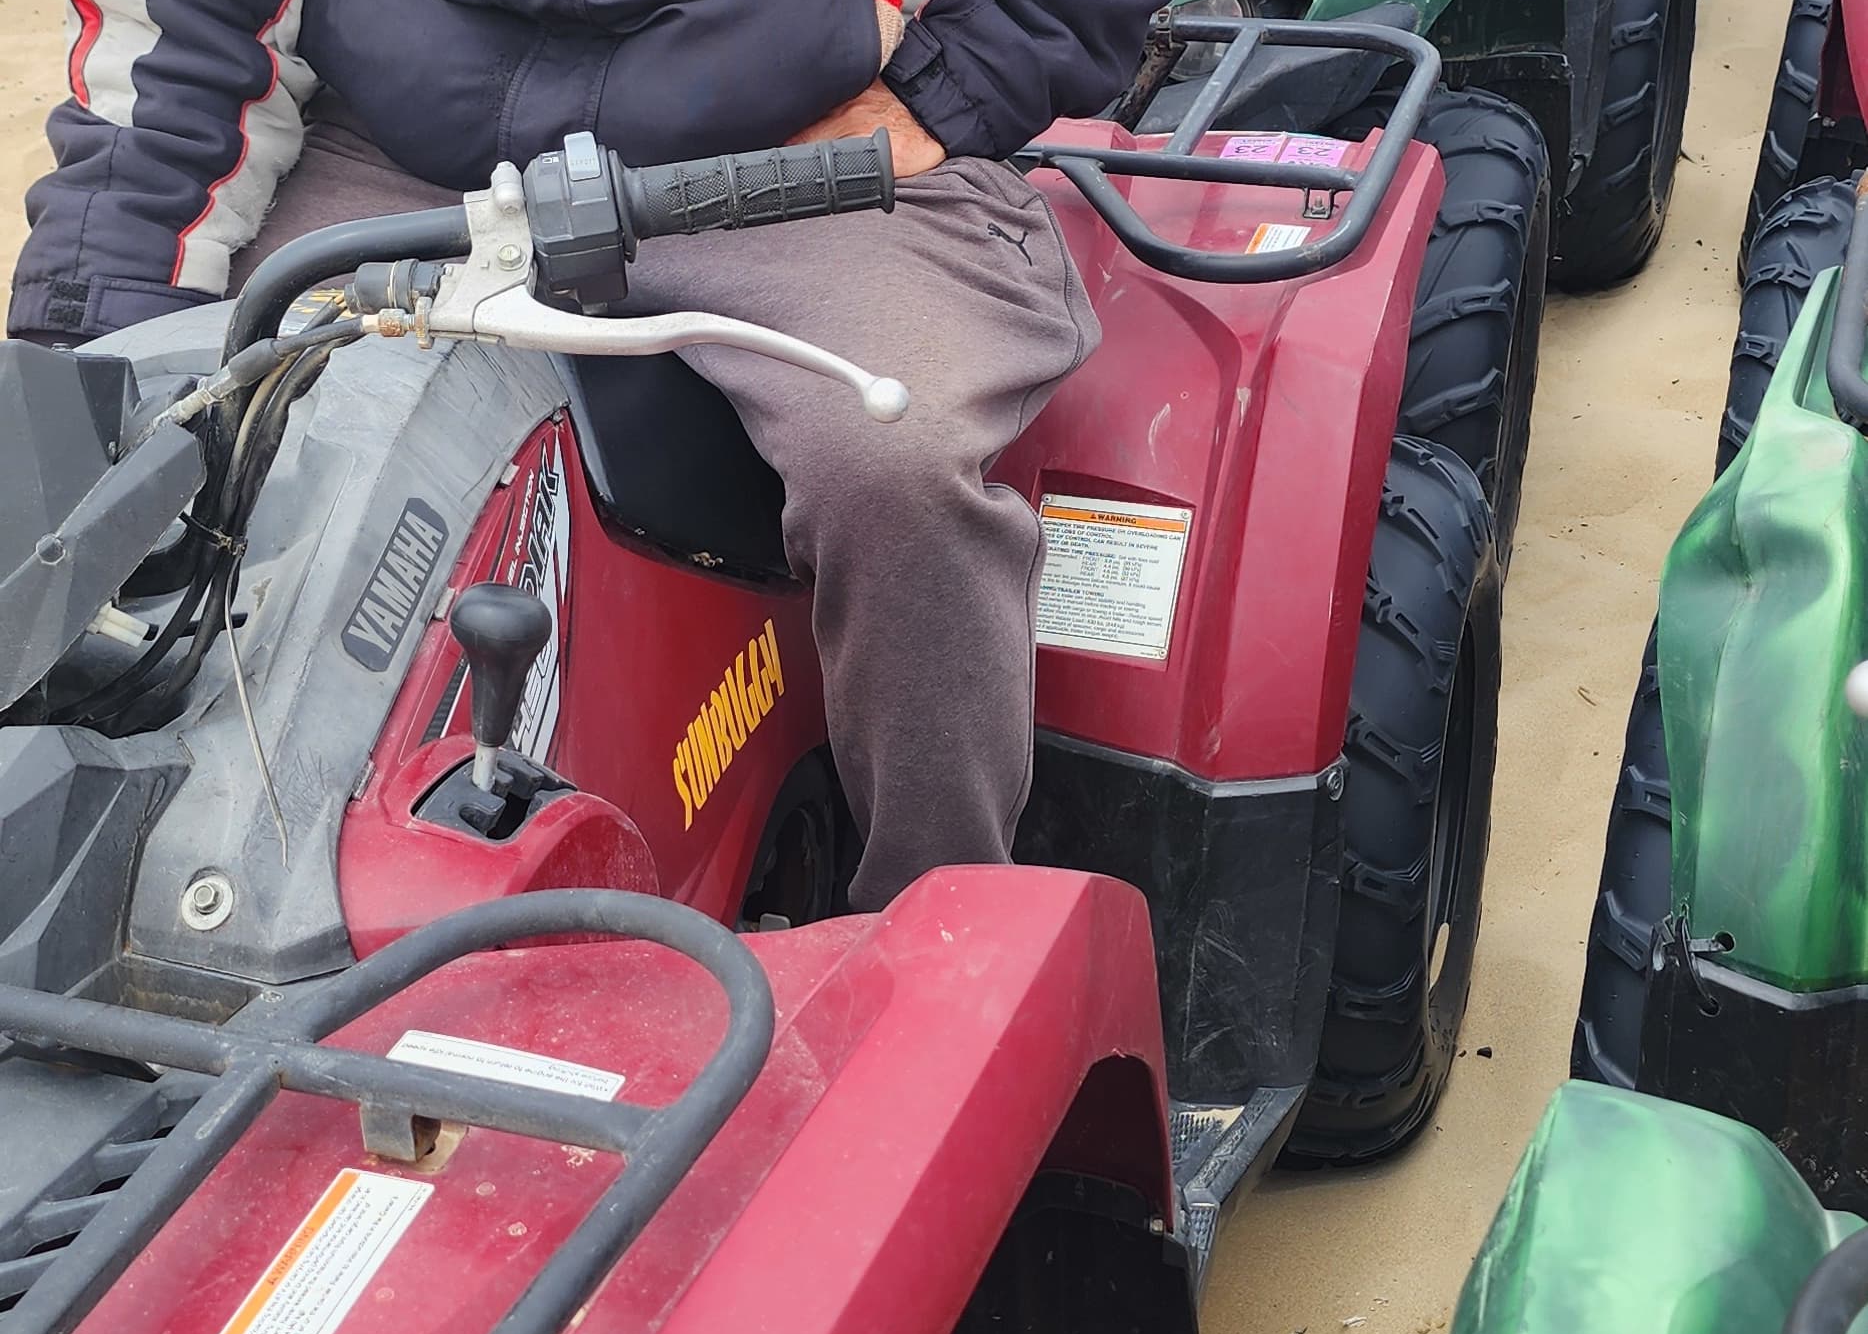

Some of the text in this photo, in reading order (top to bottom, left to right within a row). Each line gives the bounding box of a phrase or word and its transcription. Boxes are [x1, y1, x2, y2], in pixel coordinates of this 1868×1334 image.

[515, 467, 535, 556] INJECTION
[1097, 514, 1137, 525] WARNING
[348, 509, 446, 655] YAMAHA
[672, 618, 785, 832] SUNBUGGY
